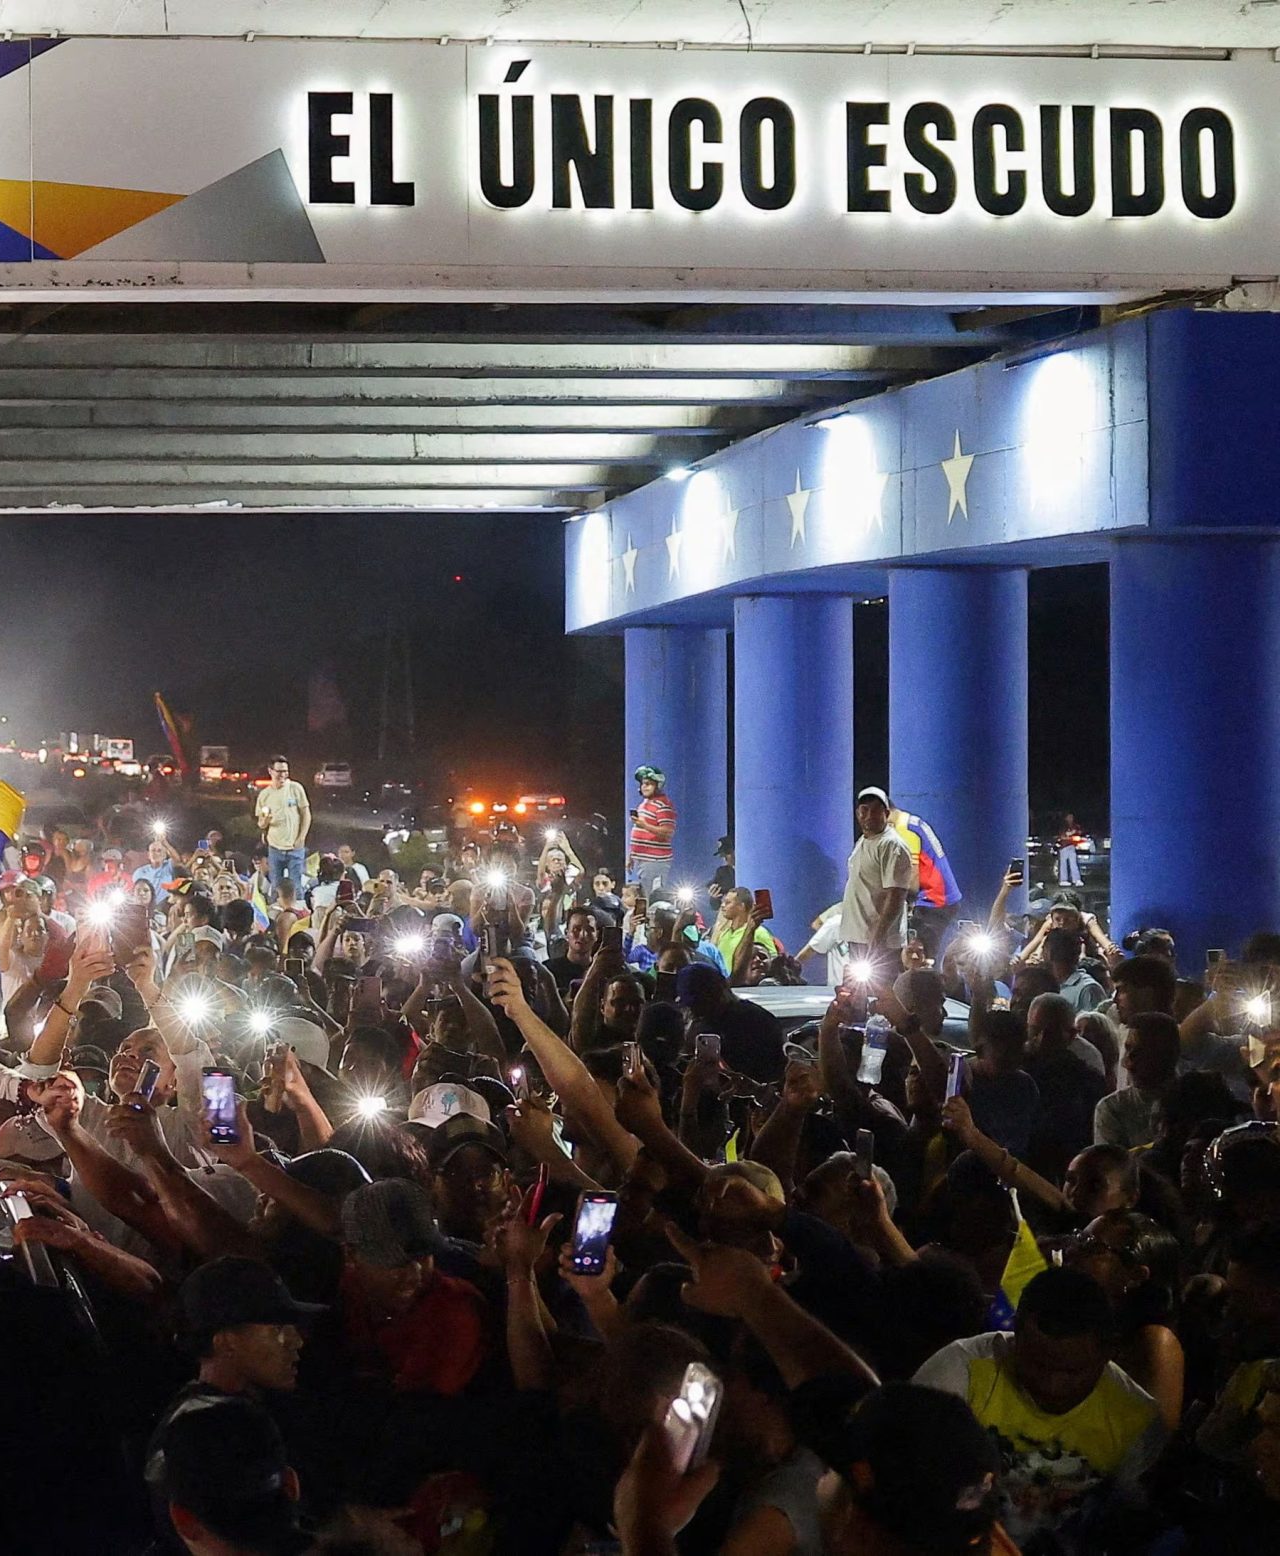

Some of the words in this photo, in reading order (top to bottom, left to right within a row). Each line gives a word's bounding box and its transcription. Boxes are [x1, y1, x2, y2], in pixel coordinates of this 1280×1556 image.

[307, 91, 415, 207] EL
[478, 59, 795, 212] ÚNICO
[846, 101, 1236, 219] ESCUDO
